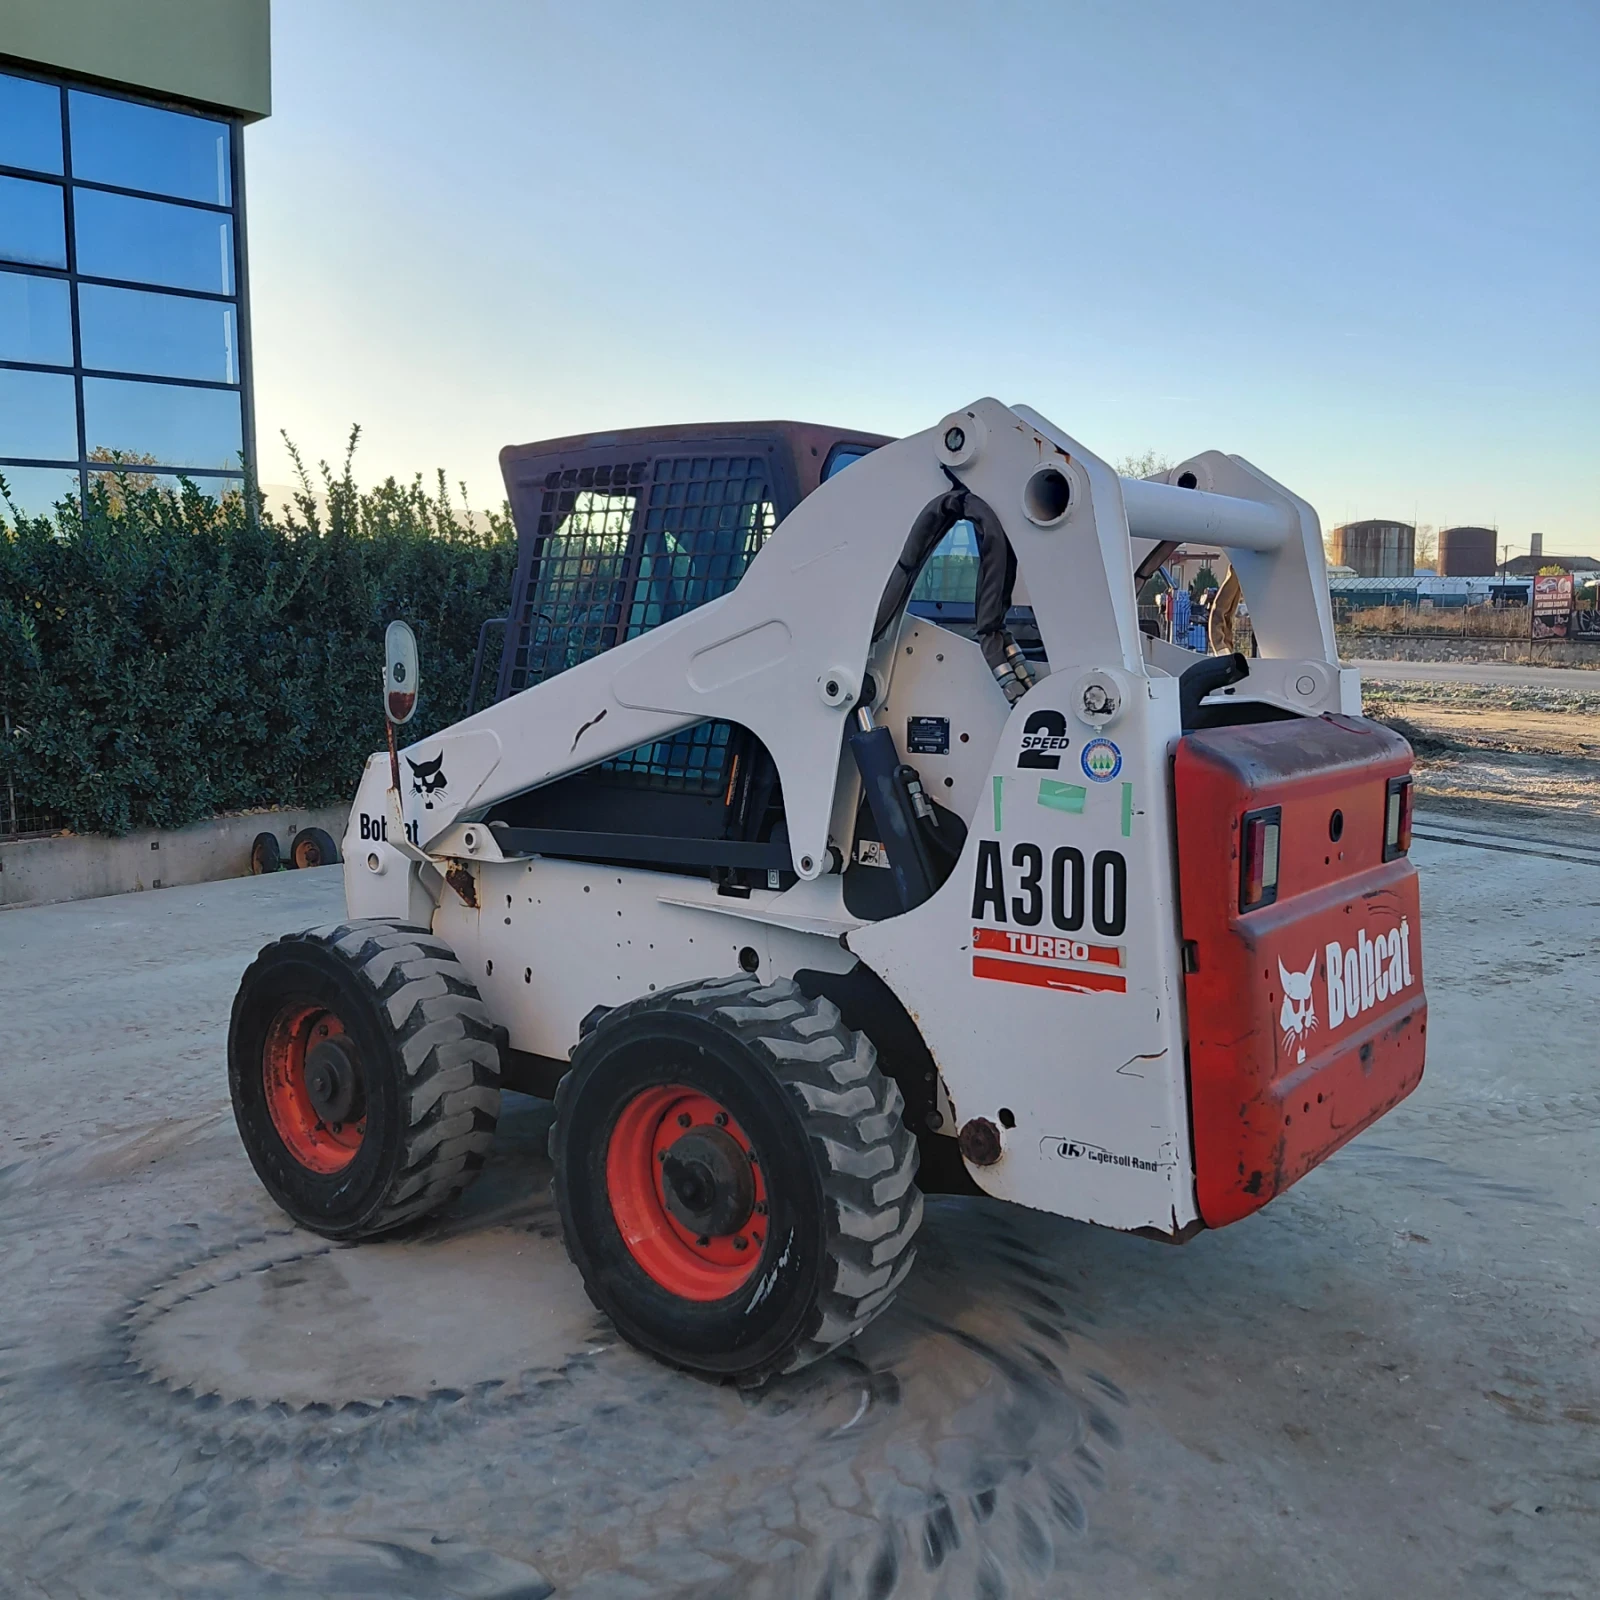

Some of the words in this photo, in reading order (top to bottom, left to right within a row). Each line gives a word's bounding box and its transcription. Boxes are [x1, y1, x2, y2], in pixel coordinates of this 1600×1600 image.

[1017, 709, 1067, 770] 2
[1021, 736, 1070, 749] SPEED
[360, 813, 419, 846] Bobat
[971, 840, 1127, 937] A300
[1006, 932, 1089, 961] TURBO
[1325, 915, 1412, 1030] Bobcat
